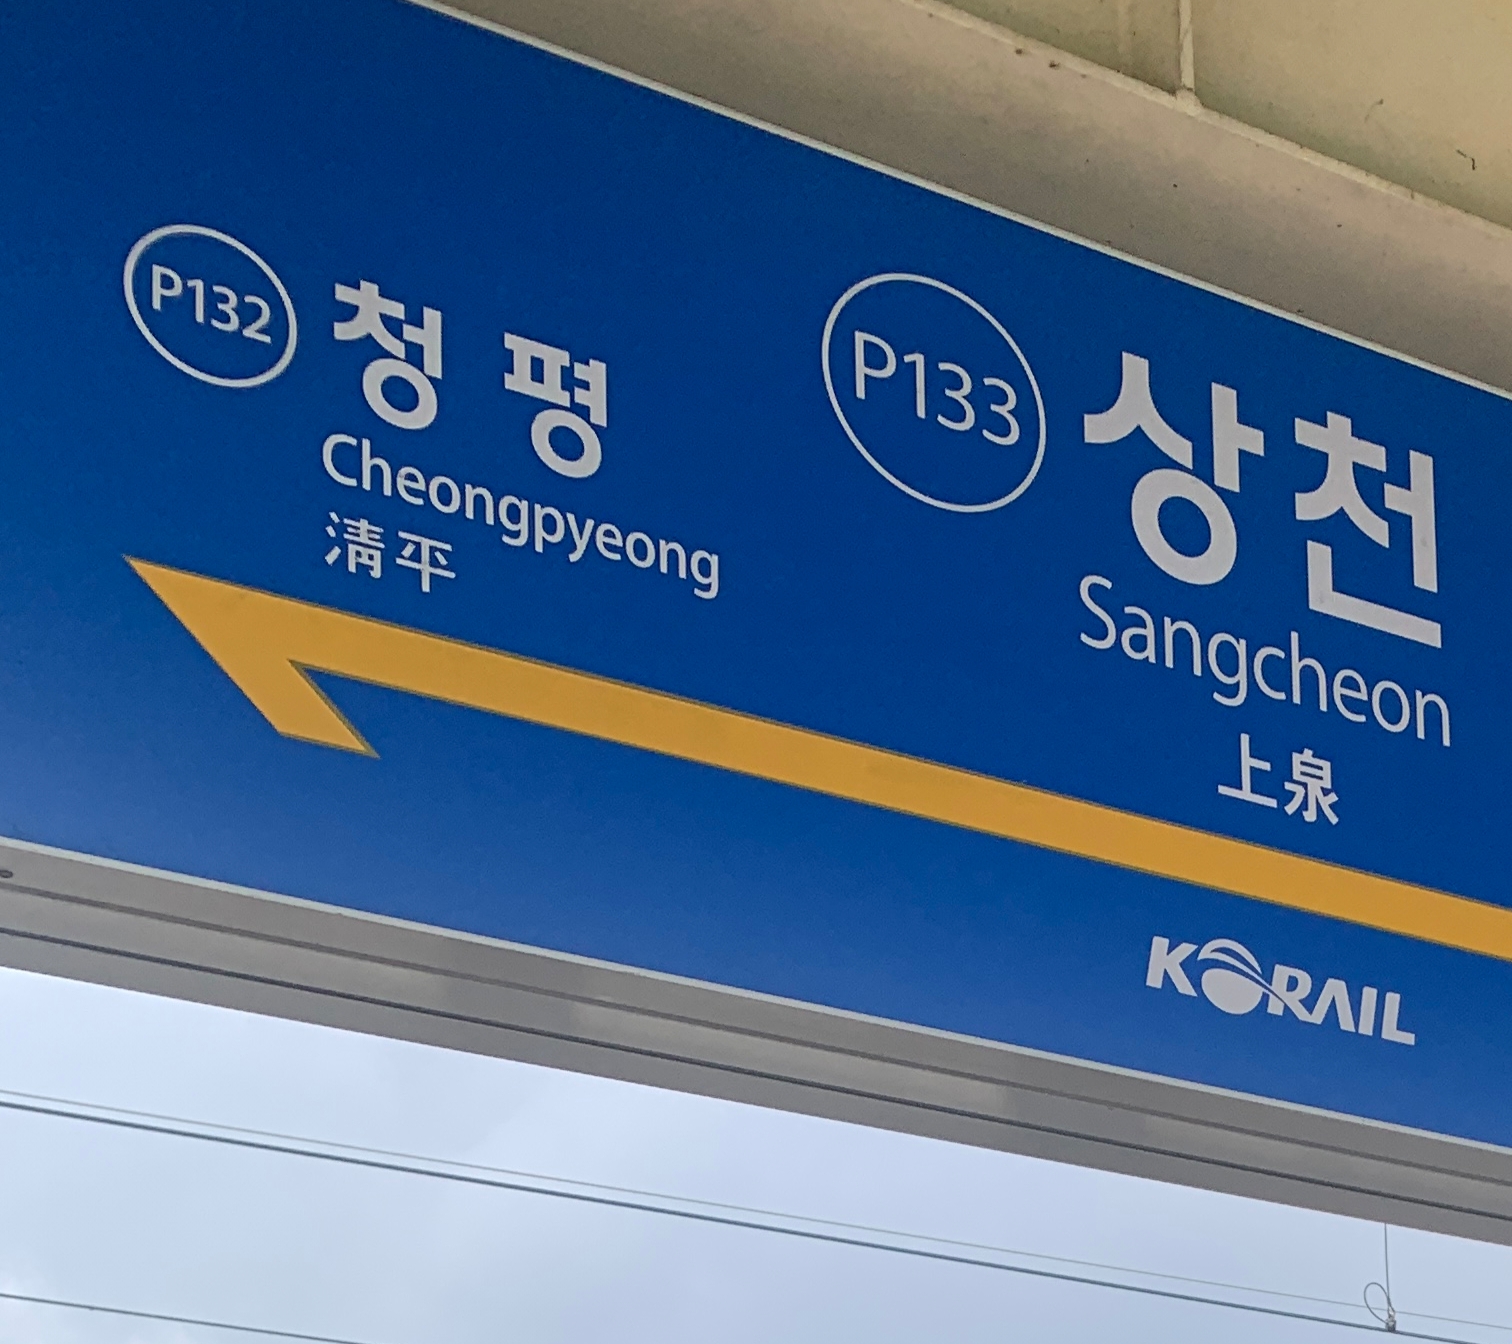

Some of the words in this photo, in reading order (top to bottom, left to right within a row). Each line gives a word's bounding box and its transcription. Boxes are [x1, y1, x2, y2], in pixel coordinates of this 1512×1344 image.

[151, 264, 273, 345] P132
[333, 279, 608, 479] 청평
[853, 329, 1021, 446] P133
[322, 433, 720, 600] Cheongpyeong
[1083, 350, 1443, 649] 상천
[1079, 574, 1451, 748] Sangcheon
[1217, 732, 1339, 825] 上泉
[1144, 934, 1416, 1047] KORAIL
